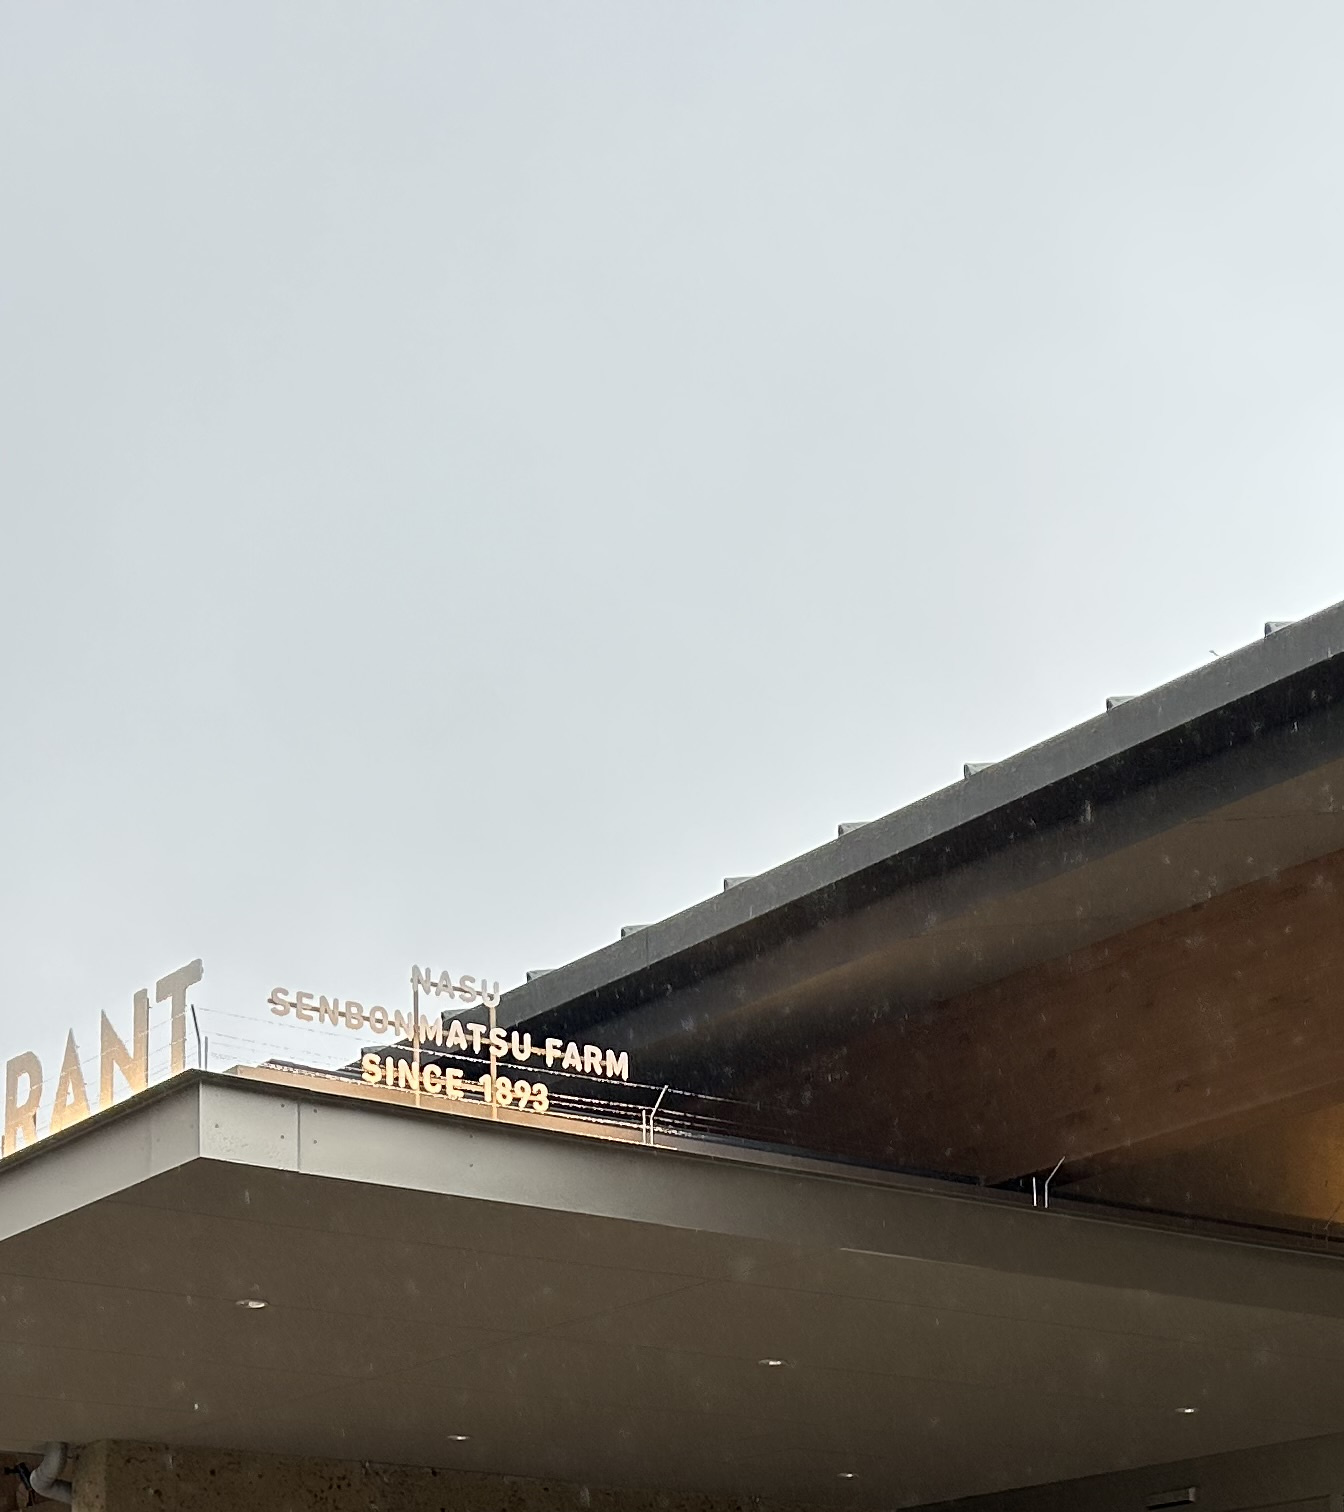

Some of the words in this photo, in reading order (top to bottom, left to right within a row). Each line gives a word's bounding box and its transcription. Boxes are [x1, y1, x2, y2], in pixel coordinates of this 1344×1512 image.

[411, 964, 500, 1008] NASU
[268, 986, 532, 1061] SENBONMATSU
[545, 1037, 629, 1081] FARM
[361, 1053, 464, 1101] SINCE
[479, 1073, 550, 1112] 1893
